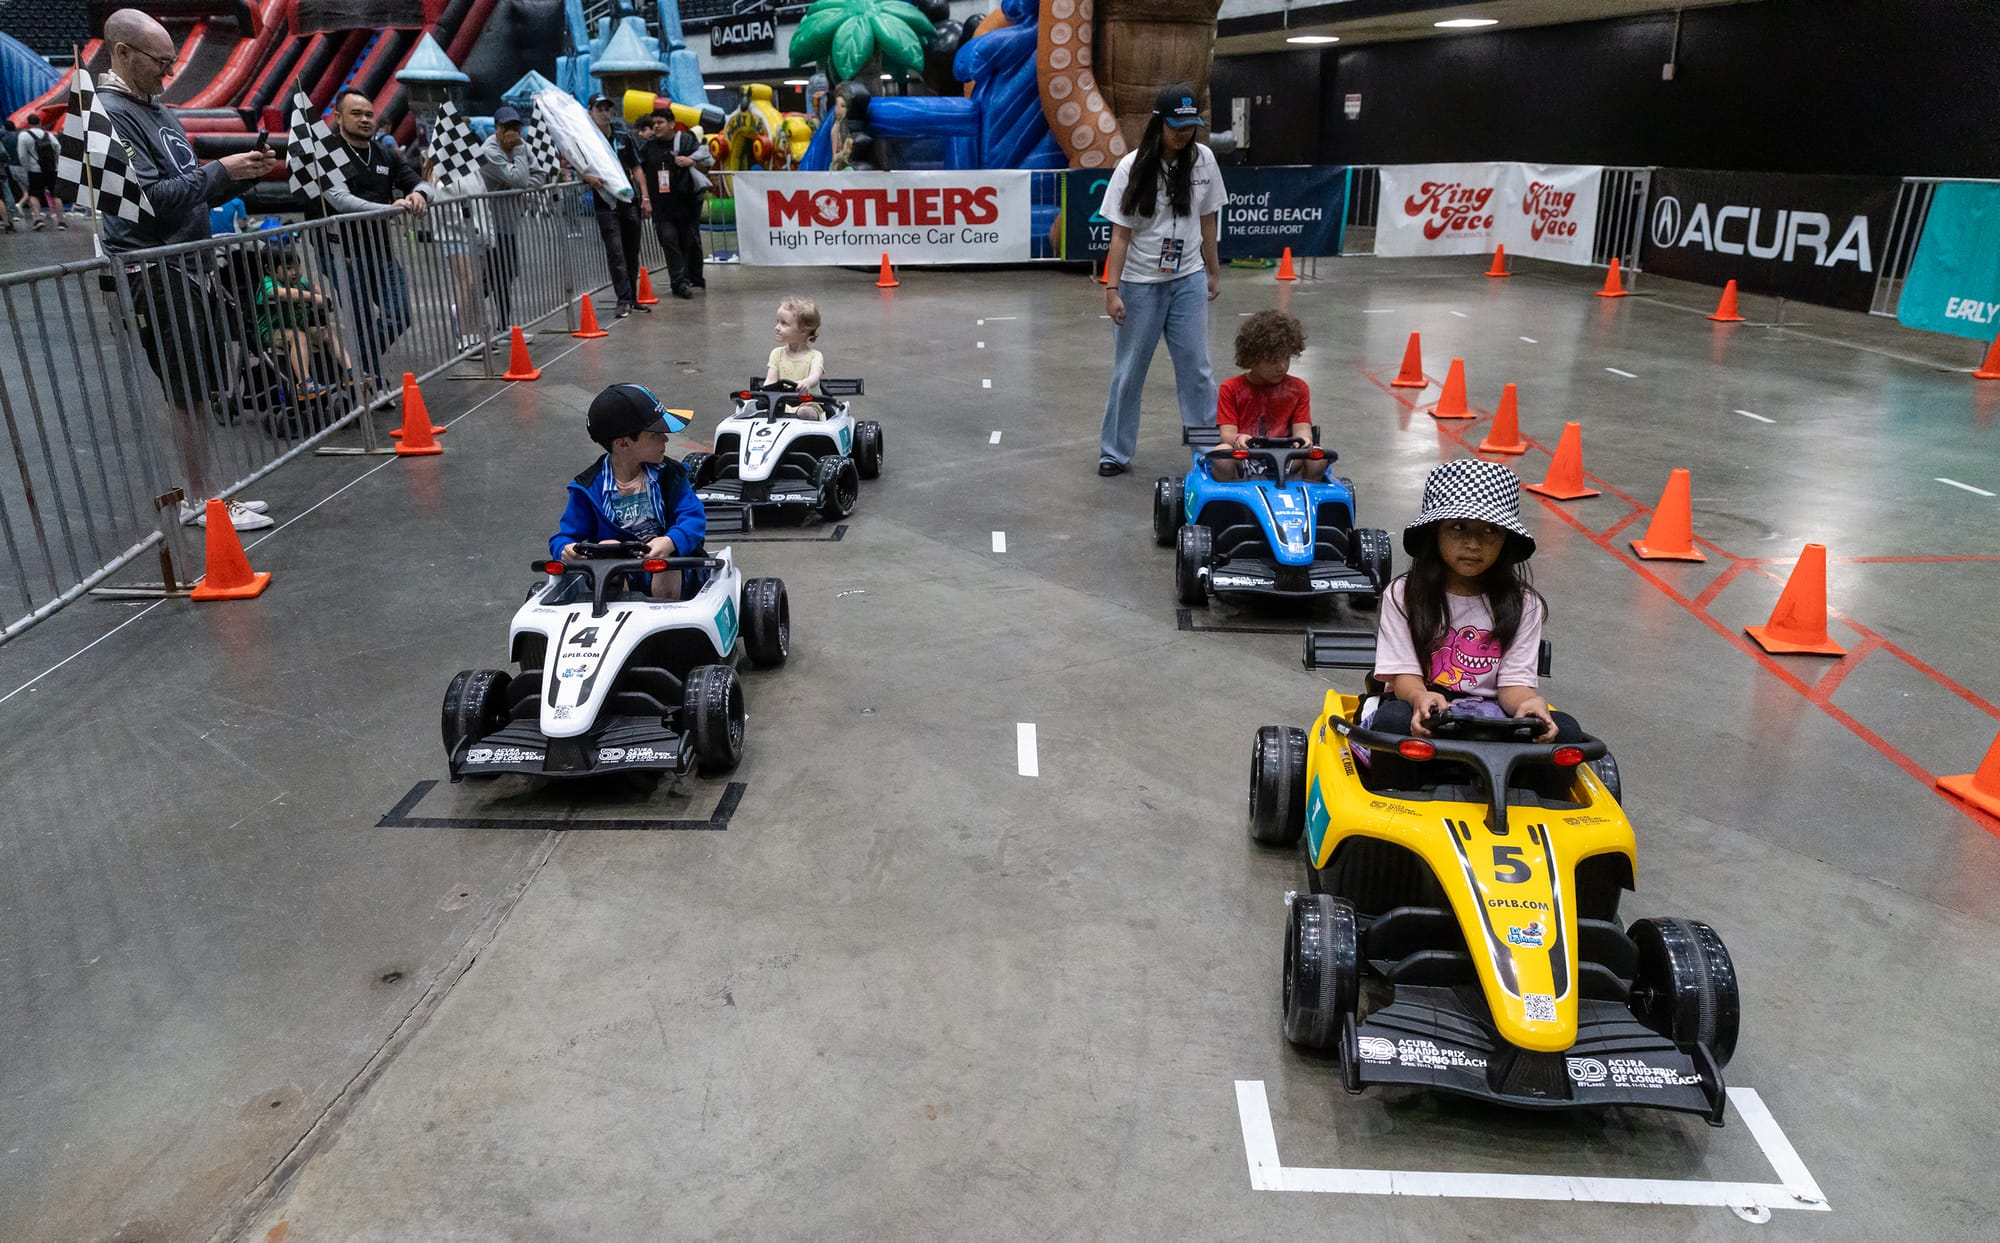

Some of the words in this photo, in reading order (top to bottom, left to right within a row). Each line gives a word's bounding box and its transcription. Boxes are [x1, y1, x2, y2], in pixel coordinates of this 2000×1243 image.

[721, 20, 774, 45] ACURA
[1229, 193, 1255, 206] Port
[1257, 192, 1270, 207] of
[1404, 181, 1494, 217] King
[1522, 181, 1576, 217] King
[767, 186, 999, 228] MOTHERS
[1228, 208, 1269, 222] LONG
[1273, 207, 1322, 221] BEACH
[1228, 226, 1246, 235] THE
[1247, 225, 1278, 235] GREEN
[1279, 224, 1304, 234] PORT
[1423, 204, 1494, 241] Taco
[1531, 208, 1577, 242] Taco
[769, 231, 808, 250] High
[814, 229, 921, 246] Performance
[927, 229, 956, 245] Car
[961, 228, 999, 244] Care
[1678, 203, 1873, 273] ACURA
[1944, 296, 2000, 324] EARLY
[756, 427, 772, 437] 6
[1278, 494, 1295, 508] 1
[568, 626, 599, 648] 4
[1492, 845, 1532, 884] 5
[1488, 899, 1550, 911] GPLB.COM
[1398, 1038, 1437, 1049] ACURA
[1399, 1046, 1440, 1056] GRAND
[1441, 1049, 1467, 1059] PRIX
[1400, 1054, 1418, 1062] OF
[1418, 1056, 1450, 1065] LONG
[1451, 1057, 1488, 1067] BEACH
[1608, 1059, 1647, 1068] ACURA
[1610, 1066, 1651, 1077] GRAND
[1651, 1068, 1680, 1078] PRIX
[1612, 1074, 1630, 1082] OF
[1630, 1075, 1664, 1084] LONG
[1665, 1073, 1704, 1086] BEACH
